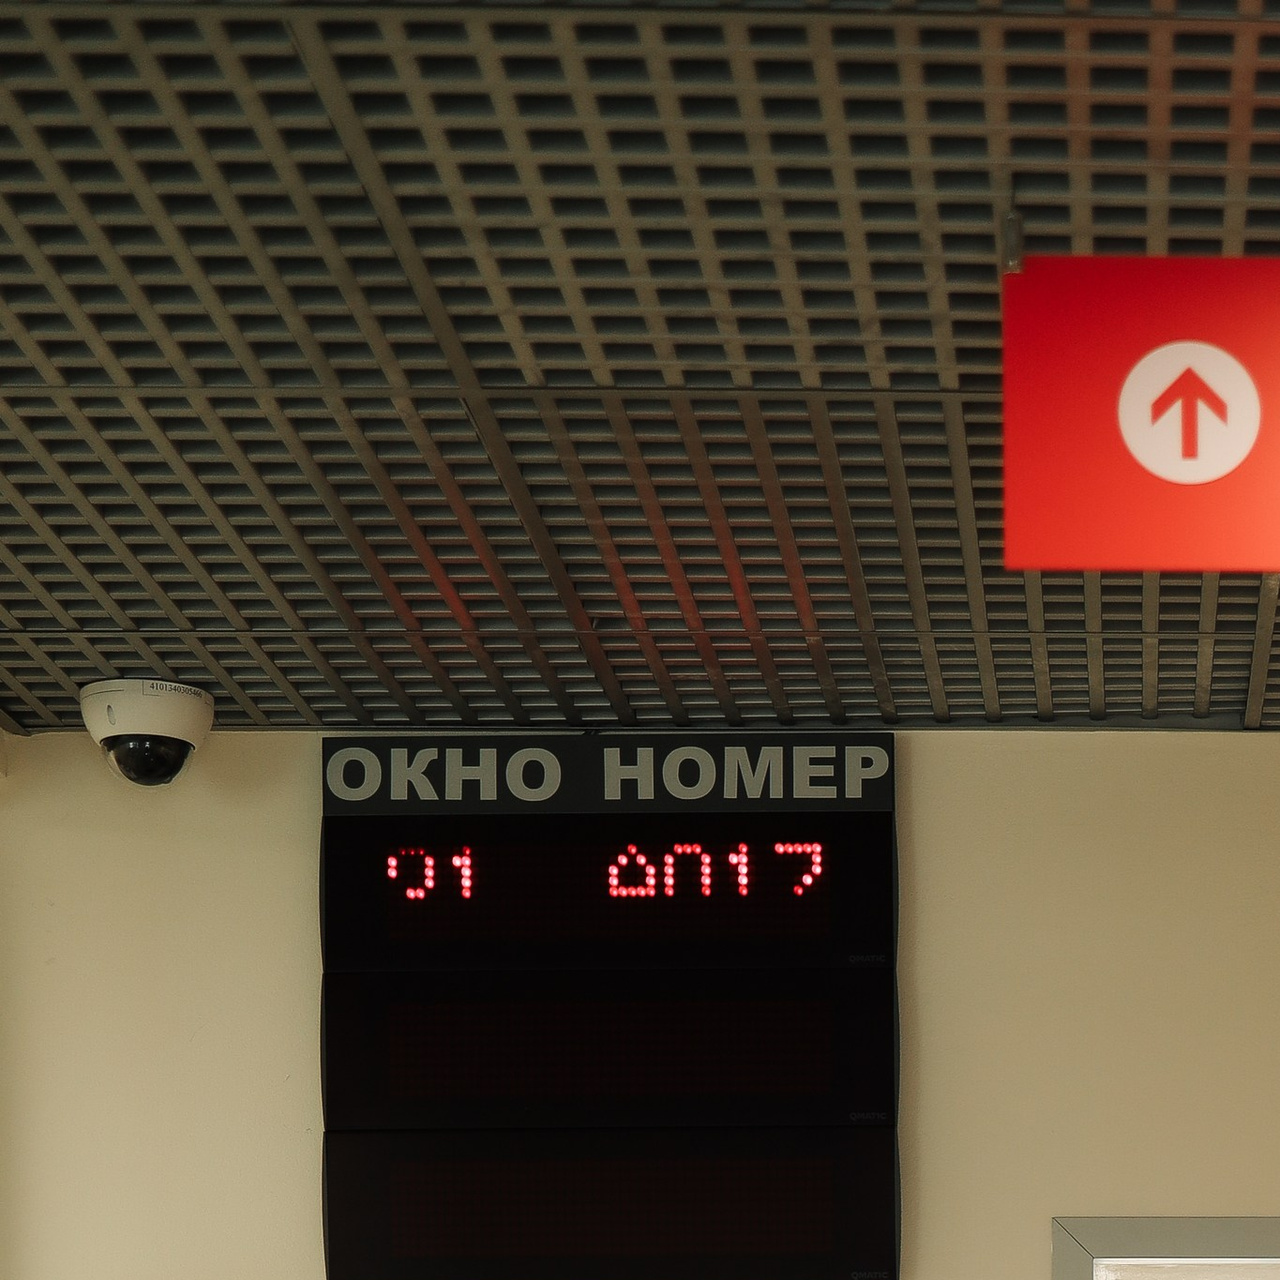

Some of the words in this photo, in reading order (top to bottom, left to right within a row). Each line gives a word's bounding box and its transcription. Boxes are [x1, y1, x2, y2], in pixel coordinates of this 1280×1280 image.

[326, 747, 562, 801] ОКНО
[604, 746, 890, 800] НОМЕР
[851, 1271, 889, 1280] QMATIC
